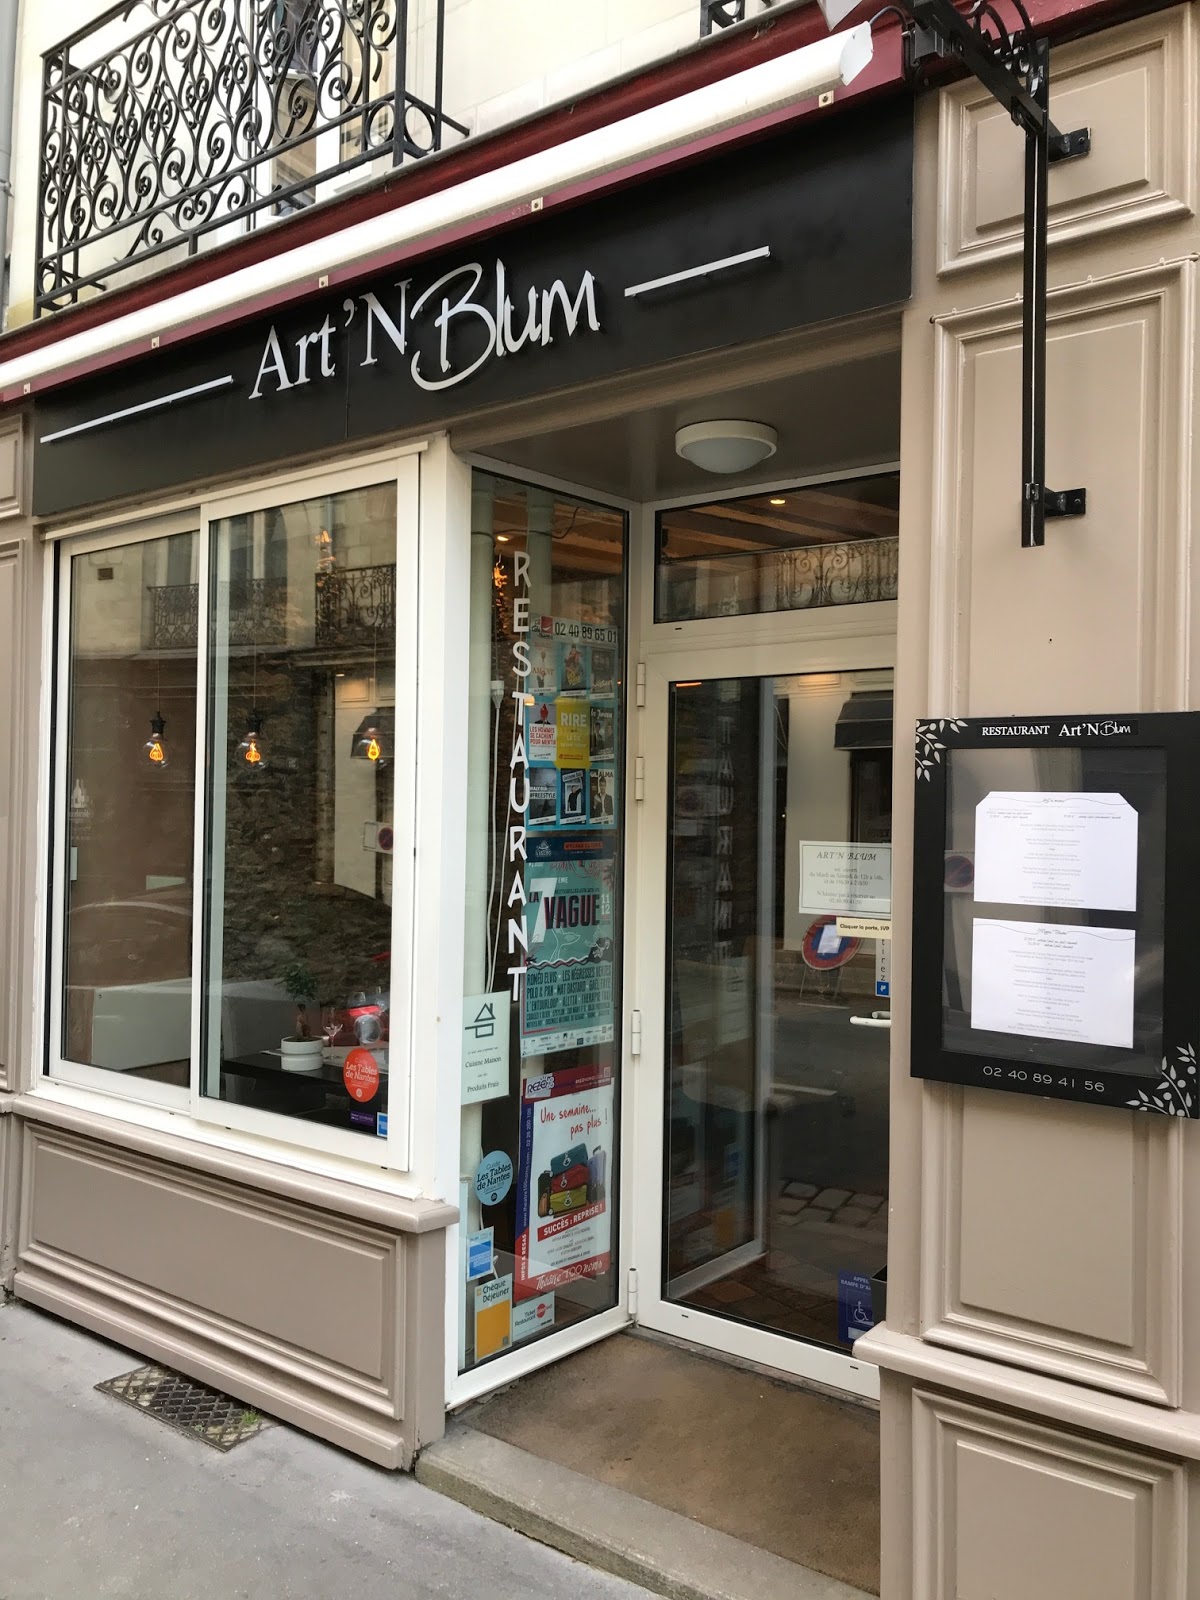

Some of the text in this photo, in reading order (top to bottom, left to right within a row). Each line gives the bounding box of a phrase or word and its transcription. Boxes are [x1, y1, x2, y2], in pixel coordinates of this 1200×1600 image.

[249, 258, 601, 400] Art'N Blum
[555, 621, 566, 636] 02
[568, 624, 579, 638] 40
[582, 626, 593, 640] 89
[594, 628, 605, 642] 65
[607, 630, 617, 643] 01
[560, 712, 587, 727] RIRE
[981, 720, 1131, 737] RESTAURANT Art'N Blum
[507, 551, 532, 1001] RESTAURANT
[816, 851, 877, 861] ART'N BLUM
[600, 893, 610, 904] 11
[528, 891, 600, 930] LA VAGUE
[601, 904, 611, 915] 12
[563, 969, 571, 982] LES
[345, 1061, 378, 1076] Les Tables
[464, 1056, 502, 1068] Cuisine Maison
[354, 1073, 376, 1083] Nantes
[982, 1065, 1105, 1093] 02 40 89 41 56
[467, 1081, 500, 1093] Produits Frais
[540, 1106, 556, 1124] Une
[570, 1123, 584, 1141] pas
[587, 1114, 602, 1135] plus
[477, 1163, 511, 1183] Les Tables
[477, 1181, 486, 1191] de
[487, 1172, 510, 1187] Nantes
[543, 1217, 569, 1236] SUCCÈS
[573, 1204, 599, 1223] REPRISE
[840, 1279, 859, 1288] RAMPE
[852, 1276, 869, 1284] APPEL
[515, 1315, 536, 1327] Restaurant
[524, 1309, 536, 1318] Ticket
